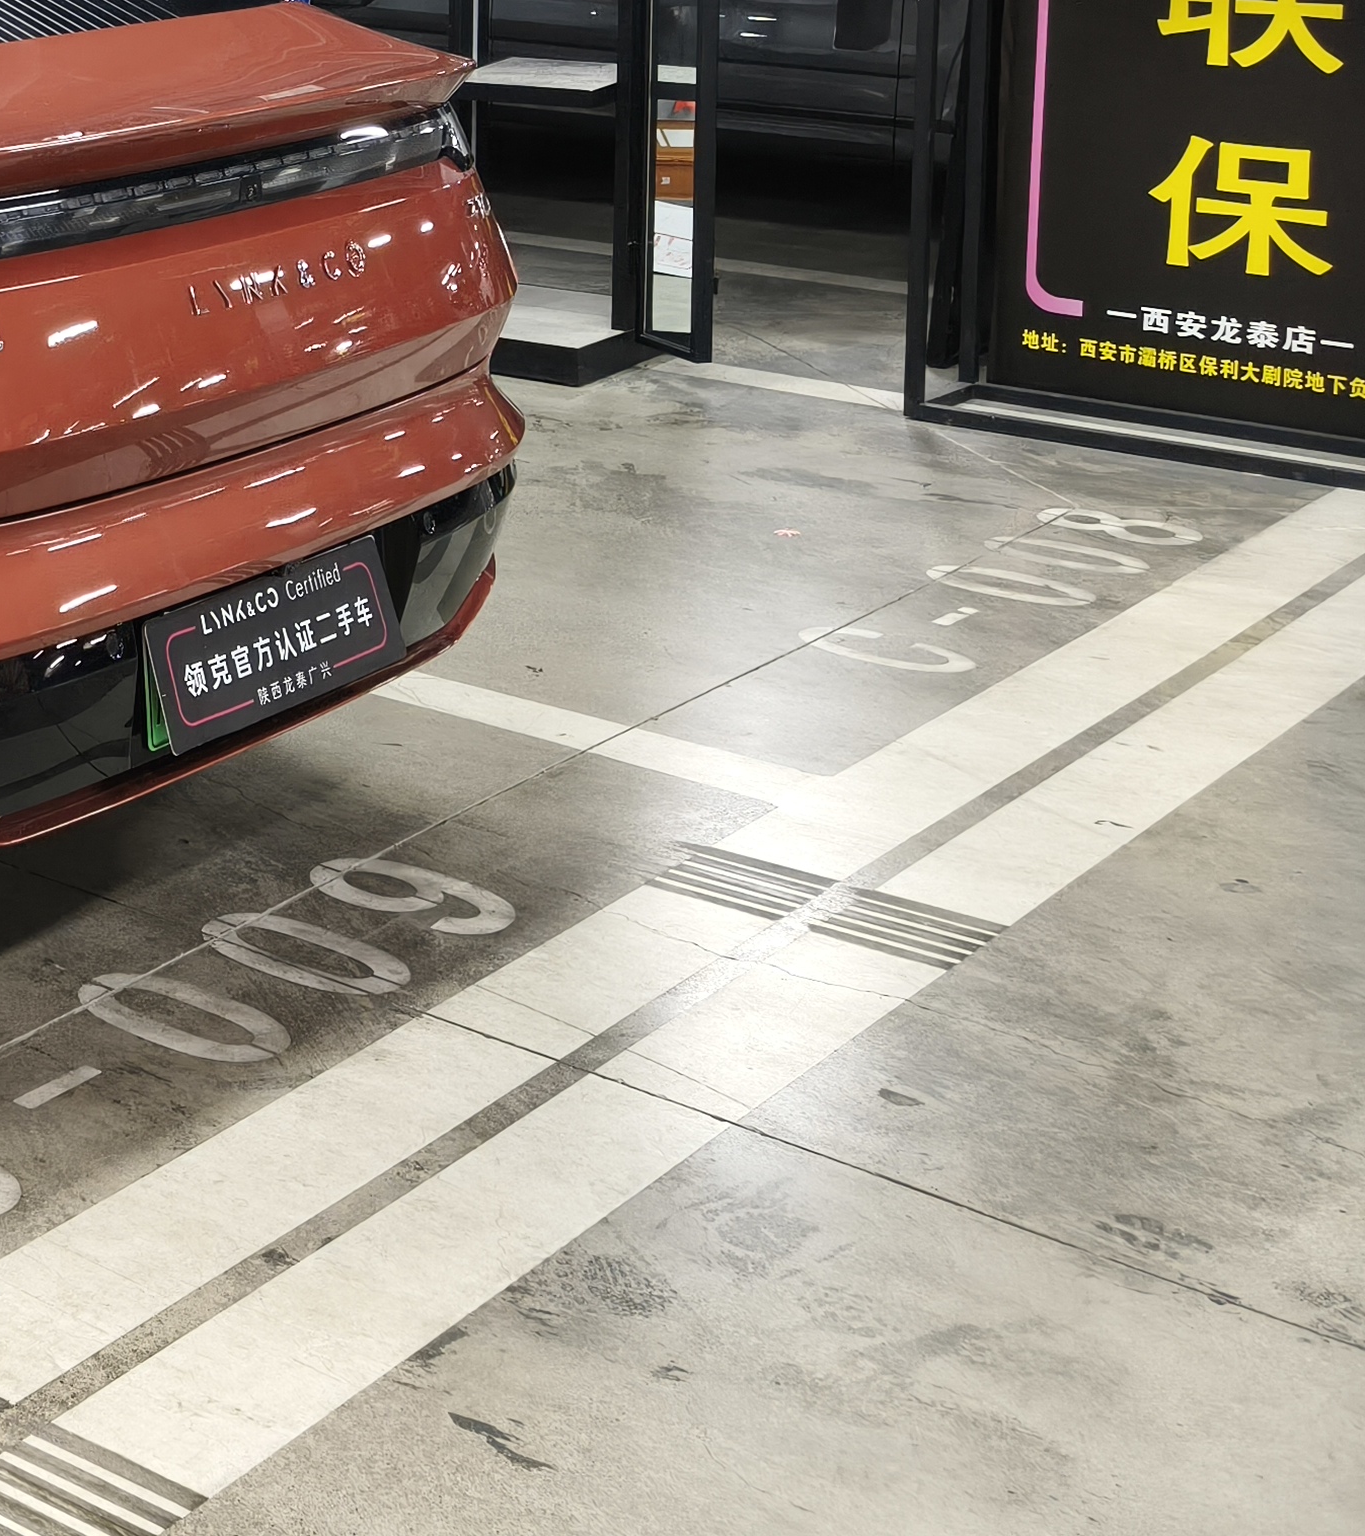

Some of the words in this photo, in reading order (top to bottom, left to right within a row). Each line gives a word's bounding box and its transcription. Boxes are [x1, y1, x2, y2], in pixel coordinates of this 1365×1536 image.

[200, 587, 279, 635] LYNK&CO
[285, 561, 342, 601] Certified
[798, 507, 1204, 673] C-008
[183, 596, 373, 698] 领克官方认证二手车
[256, 660, 333, 706] 陕西龙泰广兴
